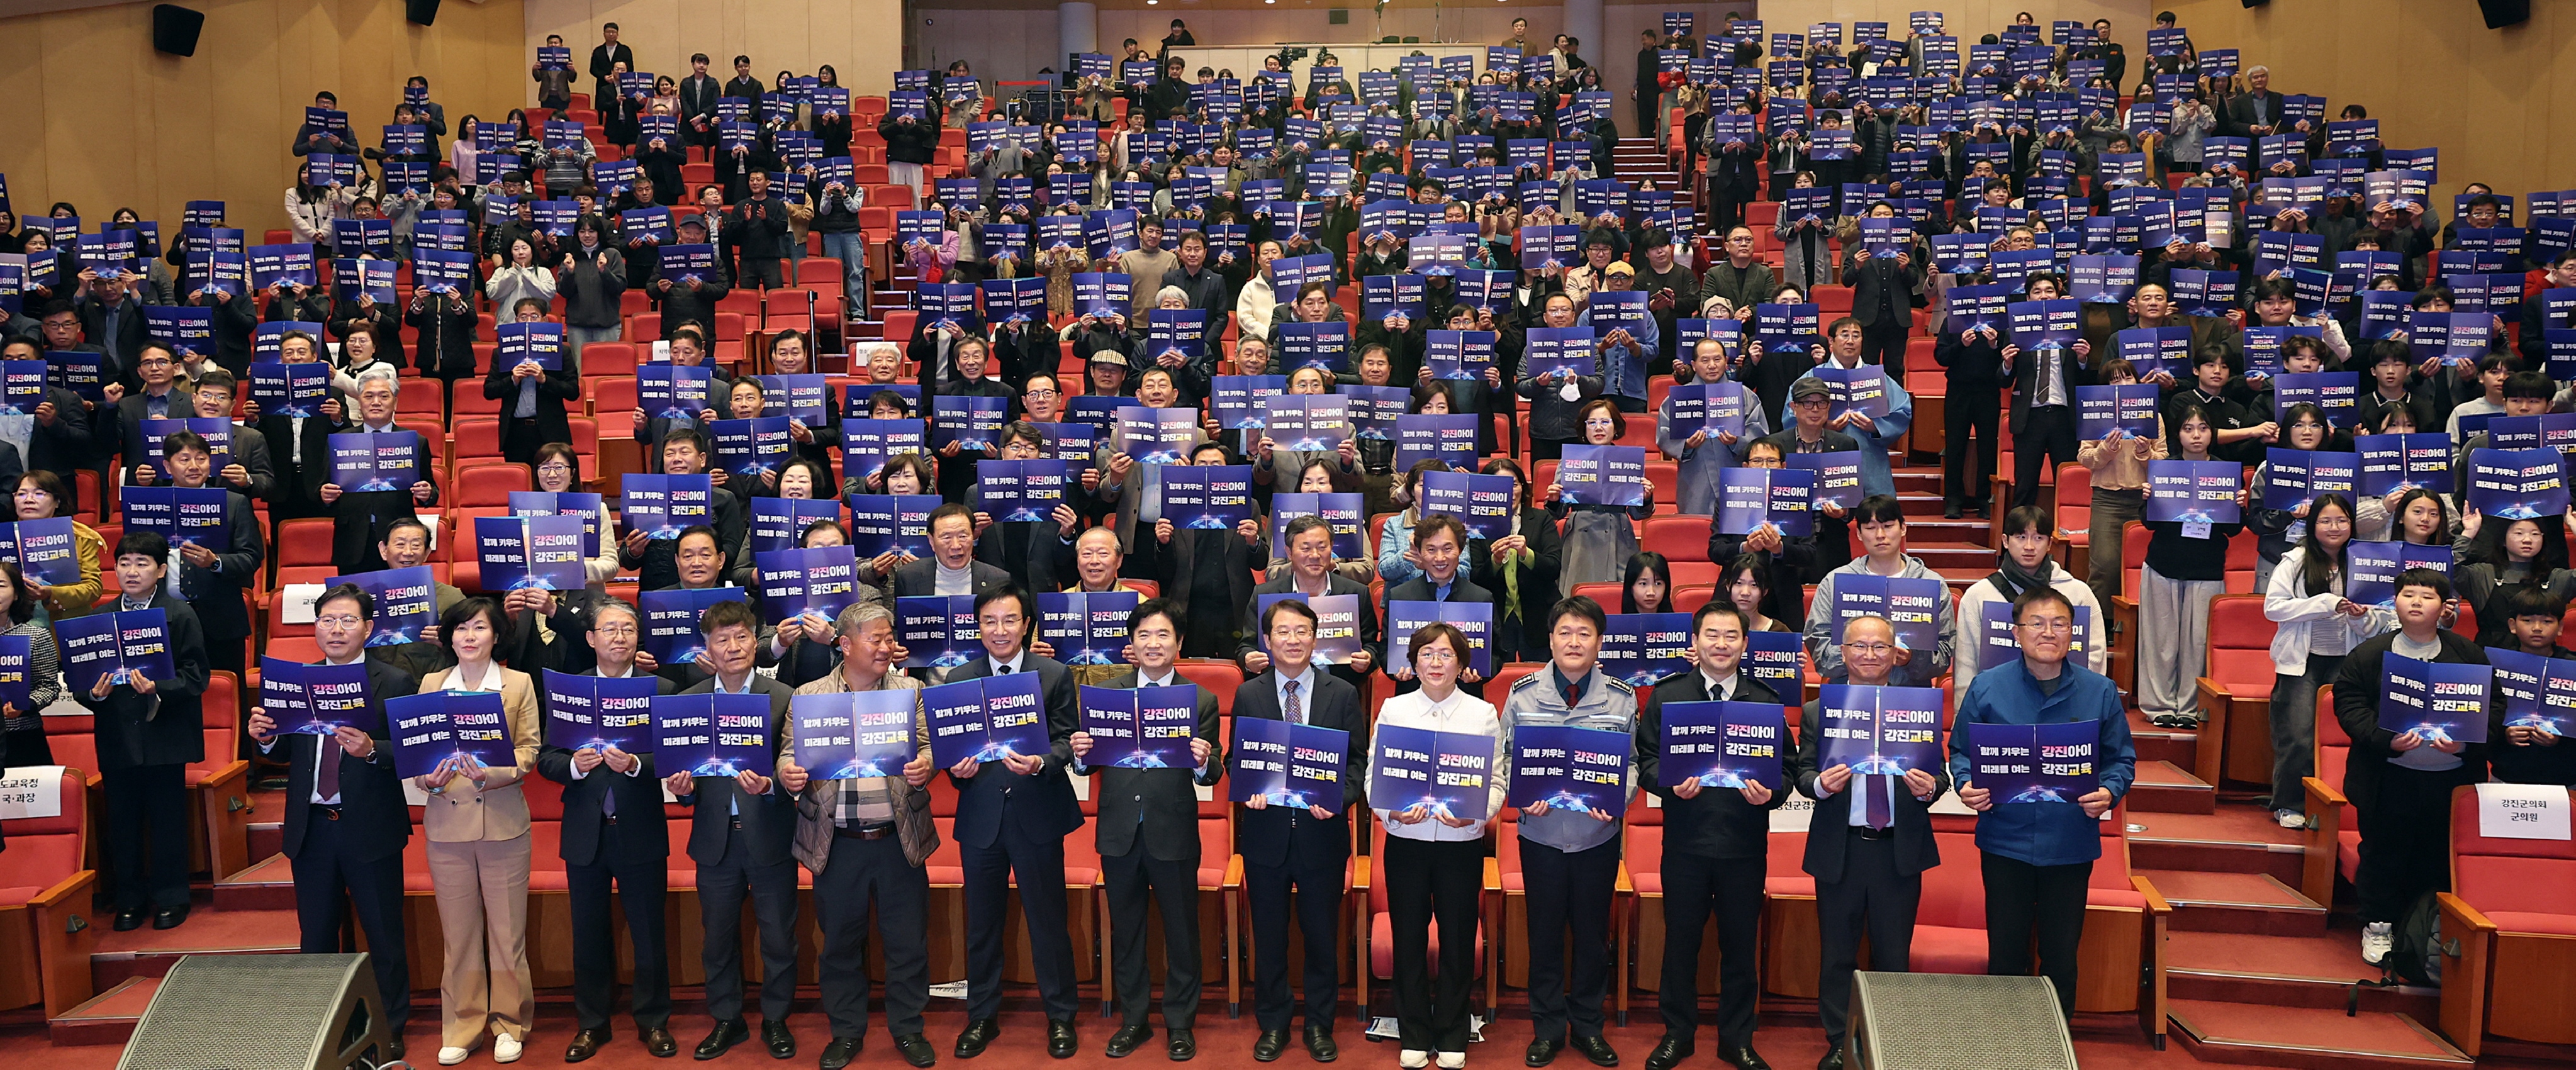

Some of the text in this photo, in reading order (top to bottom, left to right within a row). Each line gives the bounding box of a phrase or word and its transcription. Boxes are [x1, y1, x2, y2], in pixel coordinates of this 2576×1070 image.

[378, 447, 412, 455] 강진아이
[379, 459, 412, 469] 강진교육
[1027, 476, 1061, 484] 강진아이
[2198, 477, 2234, 486] 강진아이
[672, 491, 705, 500] 강진아이
[1027, 490, 1060, 499] 강진교육
[1472, 492, 1507, 502] 강진아이
[1773, 487, 1808, 497] 강진아이
[2198, 491, 2234, 500] 강진교육
[672, 506, 705, 515] 강진교육
[1471, 506, 1506, 516] 강진교육
[1772, 501, 1806, 511] 강진교육
[68, 627, 161, 647] 함께 키우는 강진아이
[71, 644, 164, 663] 미래를 여는 강진교육
[265, 680, 362, 694] 함께 키우는 강진아이
[2392, 675, 2482, 695] 함께 키우는 강진아이
[264, 698, 287, 708] 미래를
[316, 698, 364, 710] 강진교육
[552, 693, 649, 709] 함께 키우는 강진아이
[935, 694, 1035, 718] 함께 키우는 강진아이
[2390, 692, 2481, 712] 미래를 여는 강진교육
[399, 713, 498, 728] 함께 키우는 강진아이
[553, 710, 649, 727] 미래를 여는 강진교육
[804, 711, 907, 728] 함께 키우는 강진아이
[1089, 708, 1190, 720] 함께 키우는 강진아이
[1826, 709, 1934, 723] 함께 키우는 강진아이
[663, 716, 762, 728] 함께 키우는 강진아이
[938, 712, 1038, 736] 미래를 여는 강진교육
[1090, 726, 1190, 737] 미래를 여는 강진교육
[1672, 724, 1774, 738] 함께 키우는 강진아이
[1825, 726, 1933, 742] 미래를 여는 강진교육
[403, 730, 502, 746] 미래를 여는 강진교육
[663, 733, 763, 746] 미래를 여는 강진교육
[804, 730, 908, 747] 미래를 여는 강진교육
[1243, 741, 1338, 764] 함께 키우는 강진아이
[1671, 743, 1774, 757] 미래를 여는 강진교육
[1980, 744, 2091, 757] 함께 키우는 강진아이
[1386, 748, 1484, 769] 함께 키우는 강진아이
[1523, 749, 1621, 766] 함께 키우는 강진아이
[1241, 760, 1336, 782] 미래를 여는 강진교육
[1981, 762, 2092, 775] 미래를 여는 강진교육
[1, 778, 38, 788] 도교육청
[1383, 767, 1482, 788] 미래를 여는 강진교육
[1573, 769, 1619, 785] 강진교육
[3, 793, 35, 803] 국·과장
[2502, 800, 2547, 808] 강진군의회
[2511, 812, 2538, 822] 군의원
